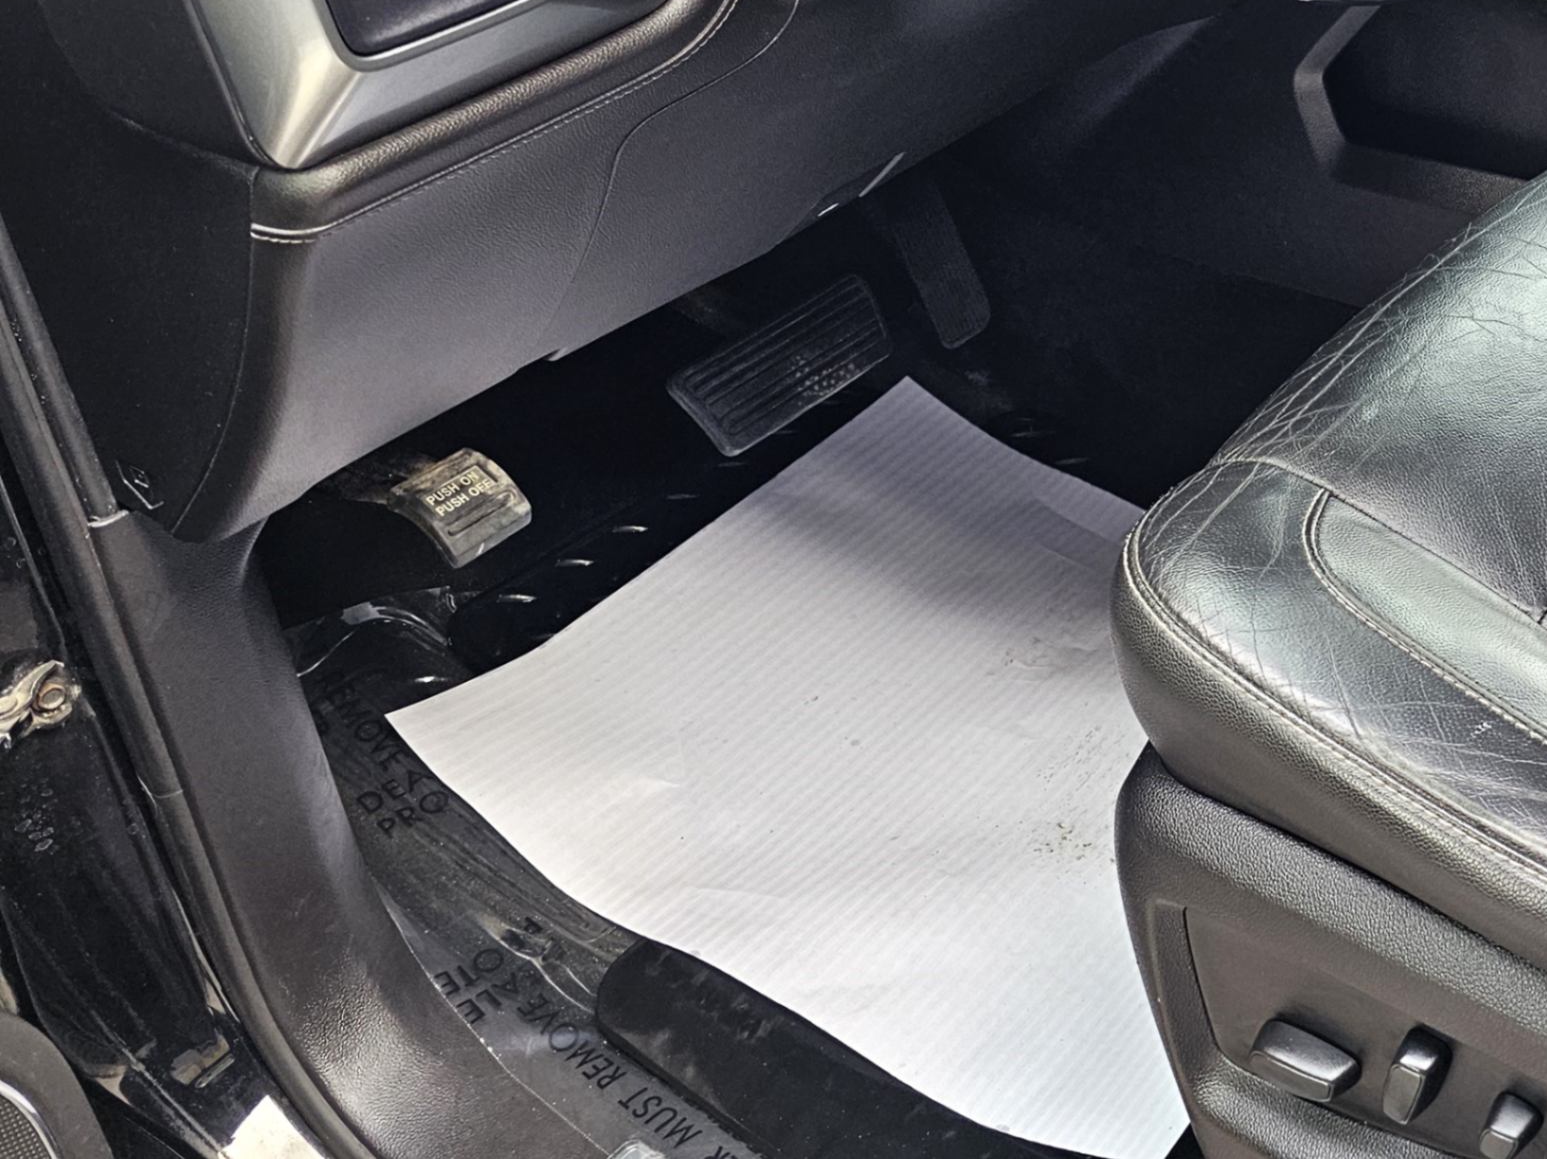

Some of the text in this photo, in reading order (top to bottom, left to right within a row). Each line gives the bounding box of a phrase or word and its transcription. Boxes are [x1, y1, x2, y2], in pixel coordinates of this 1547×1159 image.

[426, 471, 480, 506] PUSH ON
[435, 477, 493, 517] PUSH OFF
[516, 993, 703, 1149] MUST REMOVE
